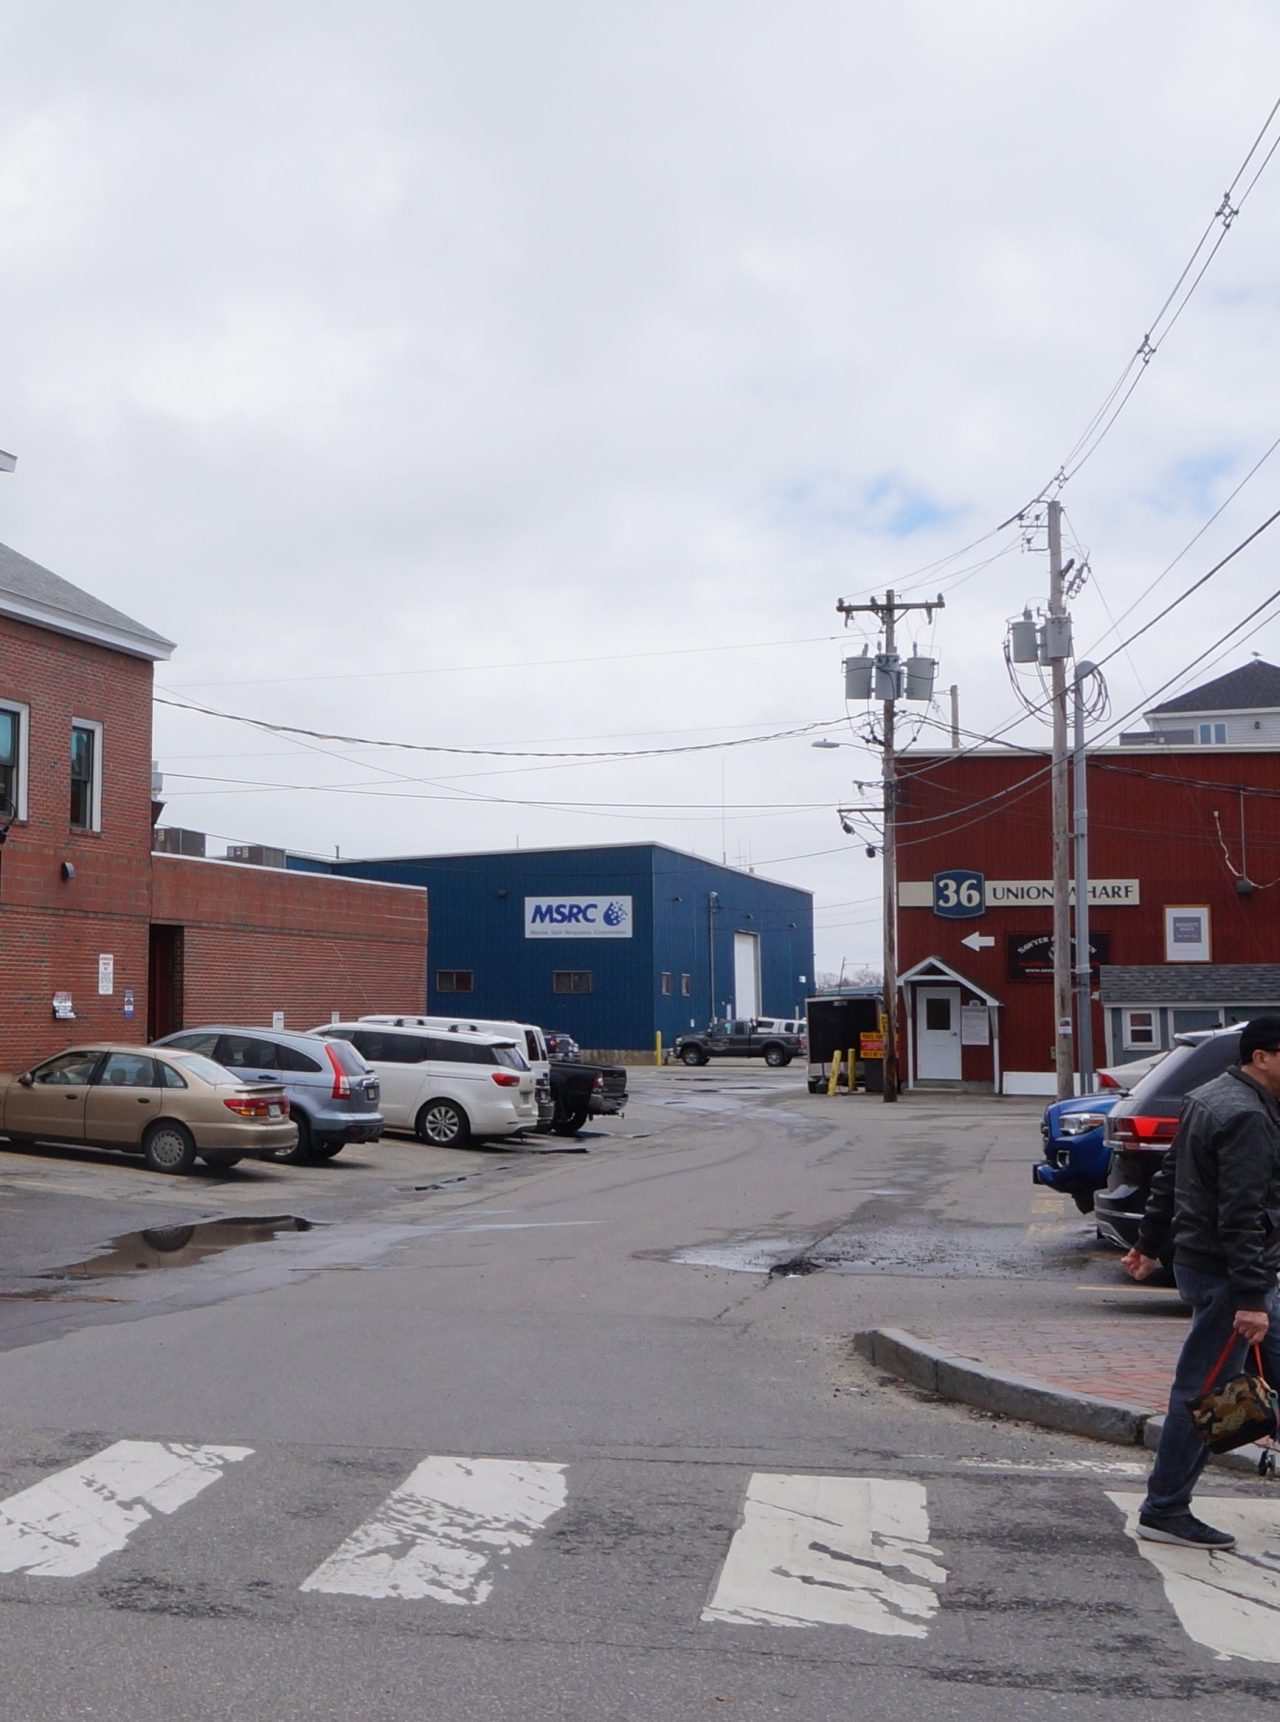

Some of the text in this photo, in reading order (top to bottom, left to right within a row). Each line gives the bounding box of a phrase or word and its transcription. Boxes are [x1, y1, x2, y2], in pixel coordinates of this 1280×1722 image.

[938, 879, 980, 907] 36
[992, 886, 1054, 900] UNION
[530, 903, 598, 924] MSRC
